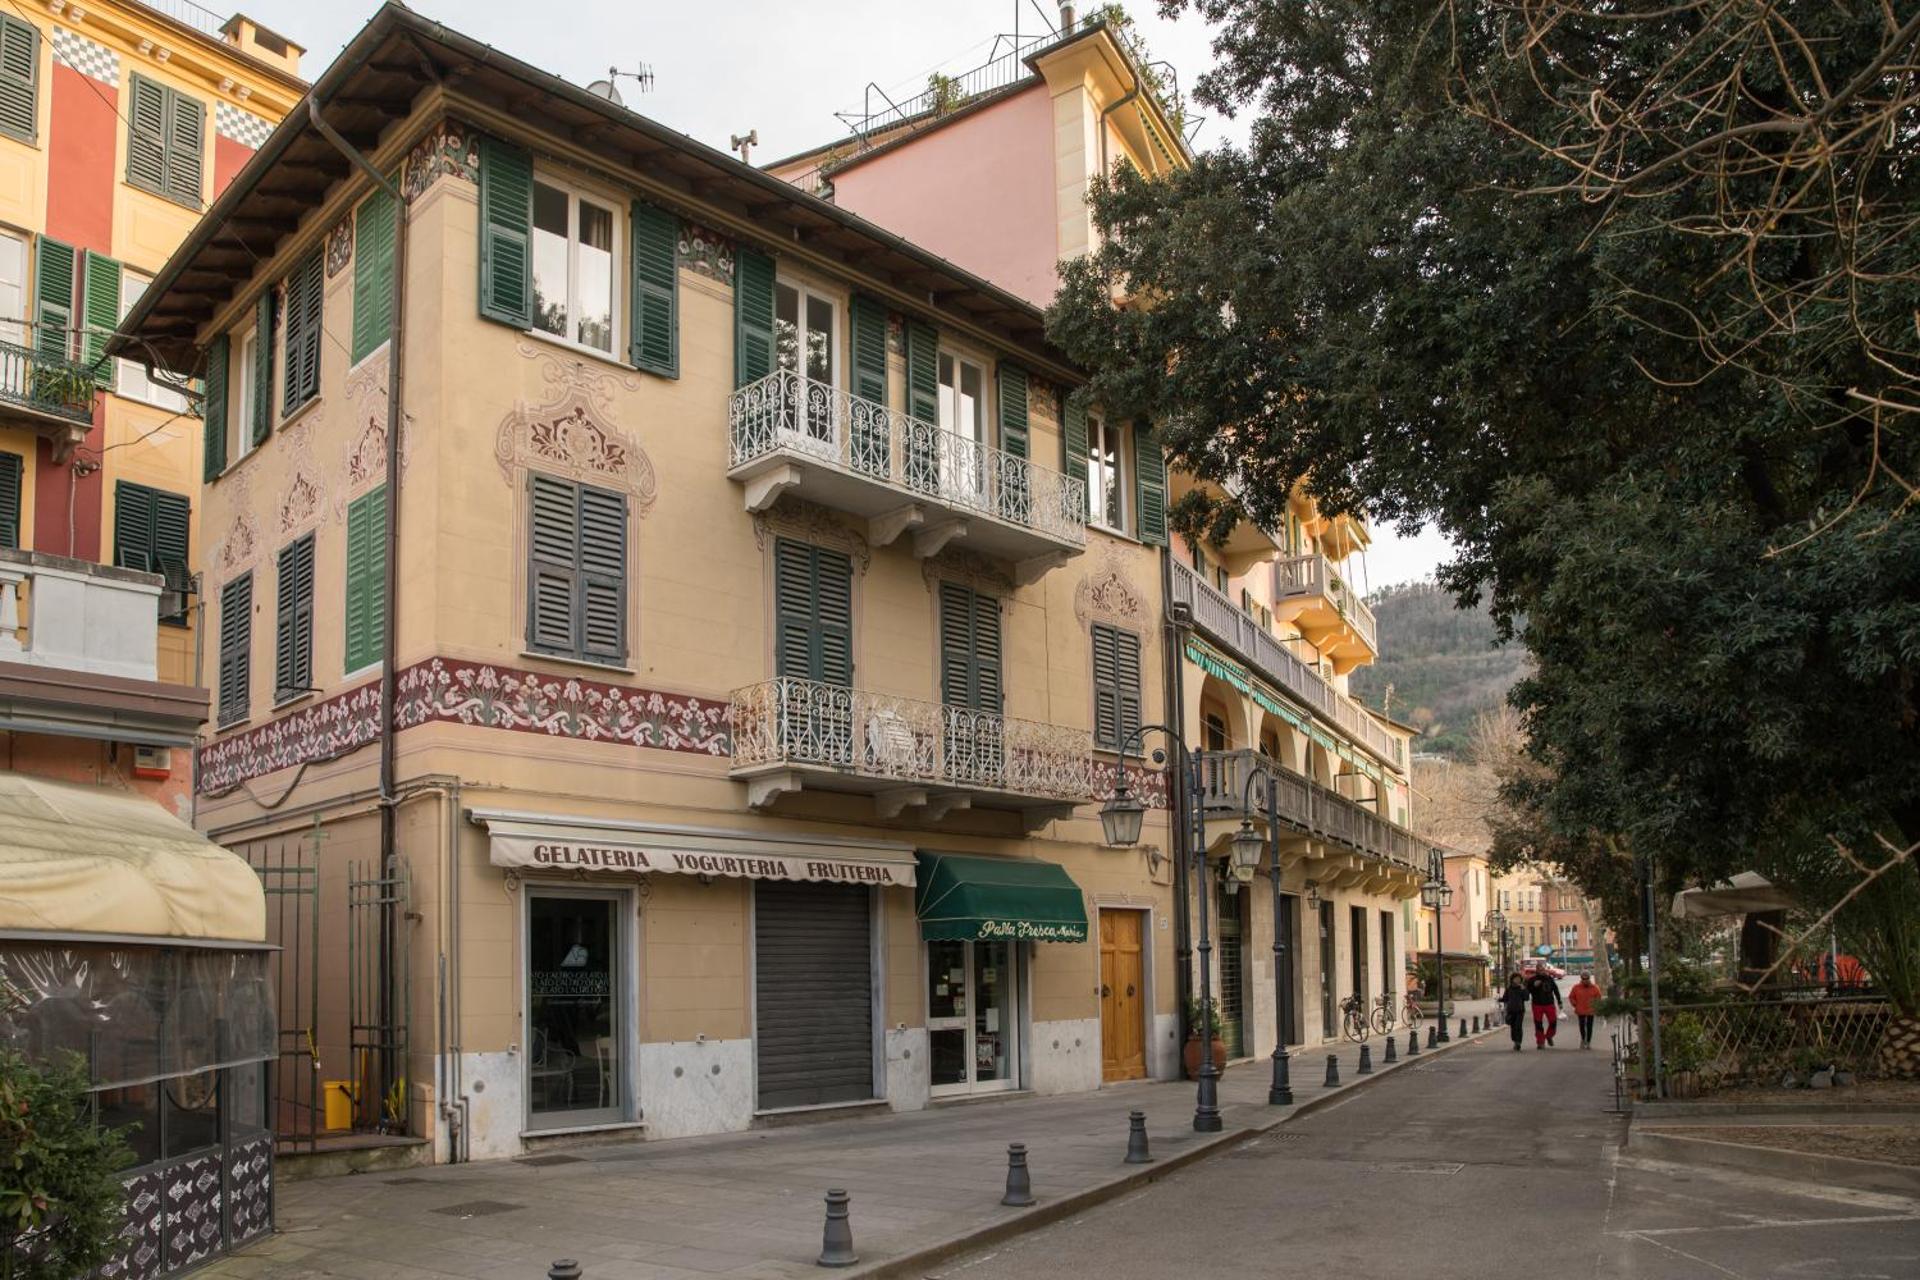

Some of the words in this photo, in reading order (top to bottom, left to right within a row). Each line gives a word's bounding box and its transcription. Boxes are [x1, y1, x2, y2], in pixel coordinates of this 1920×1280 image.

[533, 845, 650, 867] GELATERIA
[671, 853, 789, 876] YOGURTERIA
[806, 862, 893, 882] FRUTTERIA
[978, 920, 1016, 938] Pasta
[1017, 921, 1057, 938] Fresca
